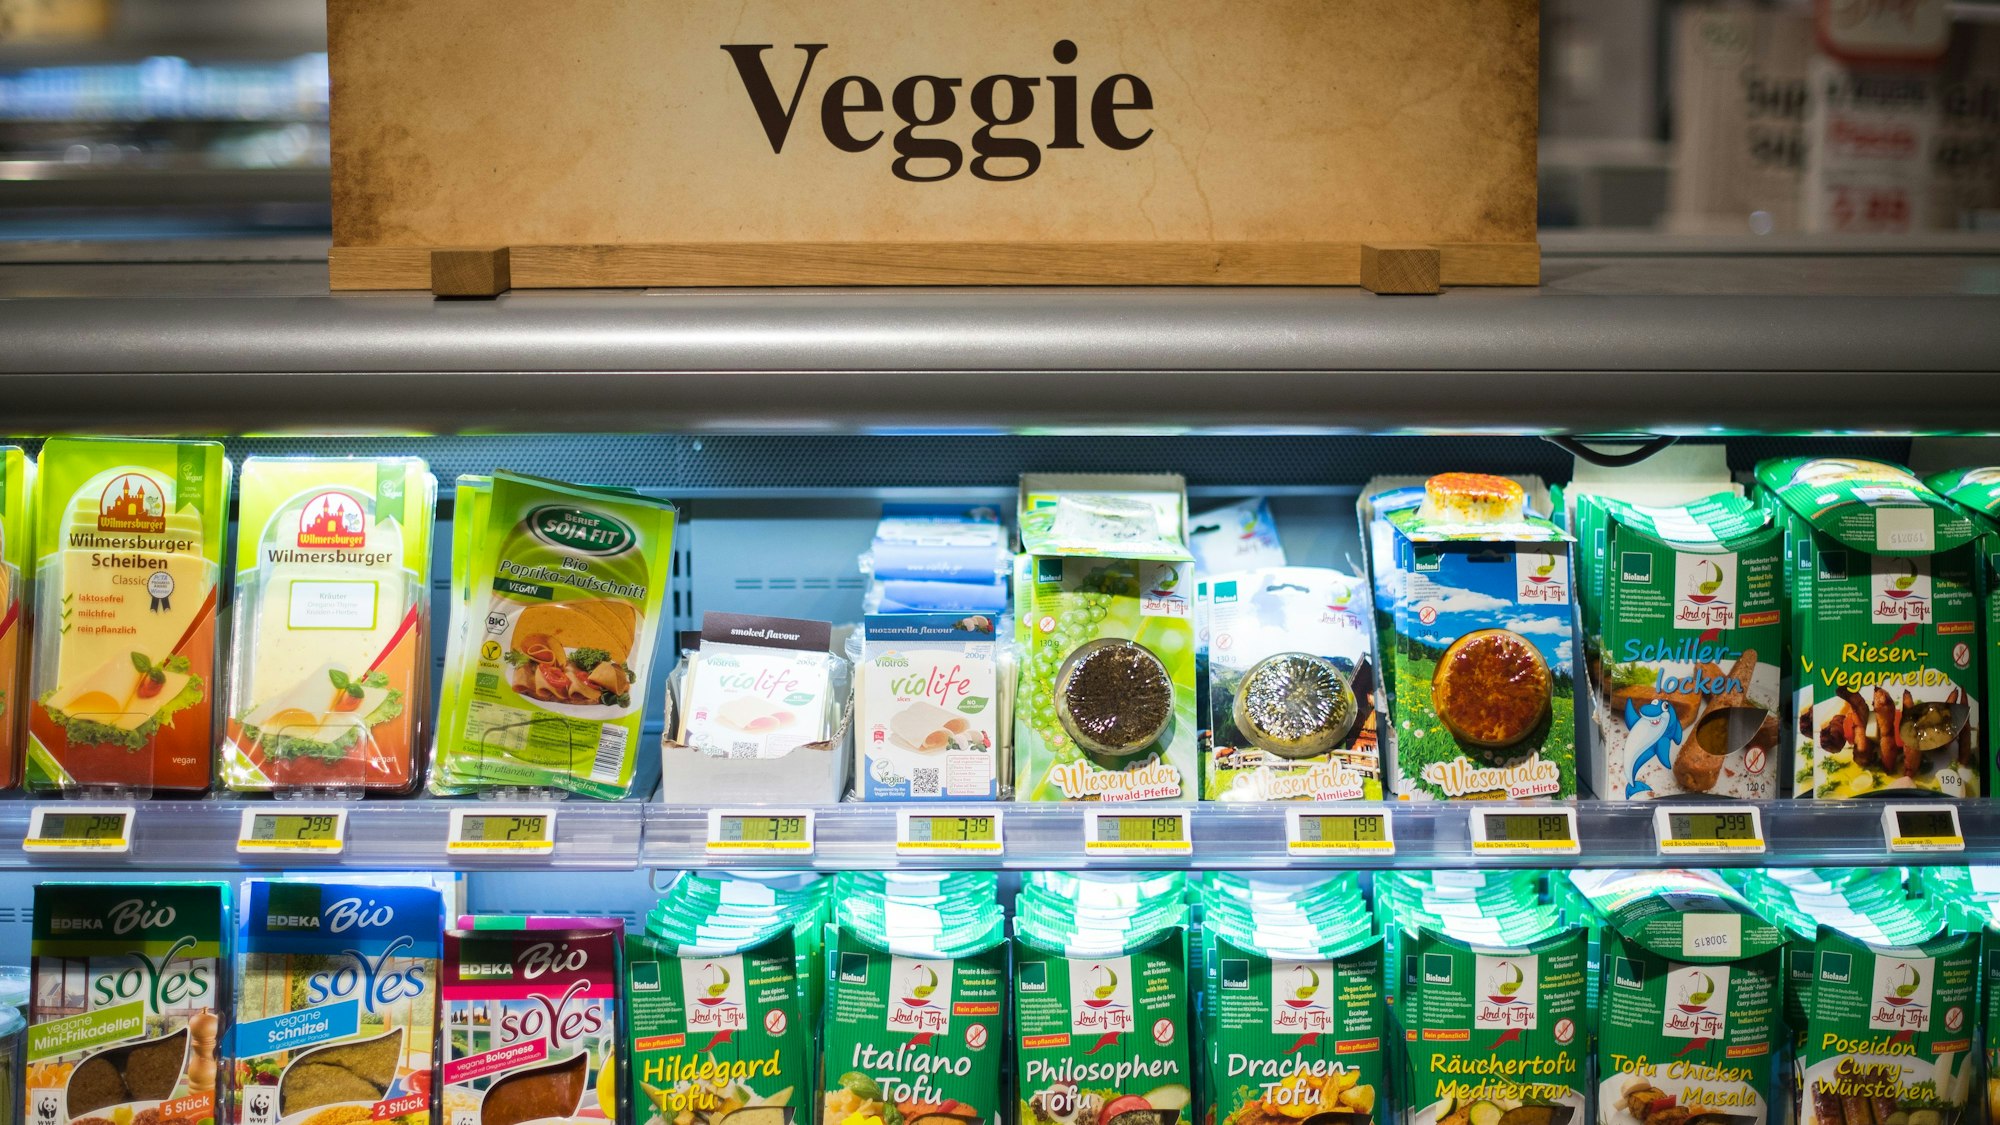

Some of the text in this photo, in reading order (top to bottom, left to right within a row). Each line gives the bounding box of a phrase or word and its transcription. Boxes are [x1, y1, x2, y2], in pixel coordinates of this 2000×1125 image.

[719, 39, 1154, 183] Veggie
[100, 517, 165, 531] Wilmersburger
[543, 519, 619, 545] SOJA FIT
[69, 533, 194, 553] Wilmersburger
[300, 534, 364, 547] Wilmersburger
[91, 553, 168, 569] Scheiben
[268, 549, 393, 566] Wilmersburger
[562, 556, 588, 572] Bio
[1416, 563, 1438, 571] Bioland
[112, 574, 147, 586] Classic
[499, 560, 647, 600] Paprika-Aufschnitt
[1040, 574, 1062, 582] Bioland
[1623, 572, 1649, 581] Bioland
[508, 582, 538, 595] VEGAN
[1520, 586, 1566, 602] Lord of Tofu
[78, 593, 124, 603] laktosefrei
[1144, 598, 1189, 615] Lord of Tofu
[78, 609, 116, 618] milchfrei
[1676, 606, 1734, 626] Lord of Tofu
[1874, 601, 1898, 615] Lord
[1898, 601, 1908, 620] of
[1907, 601, 1930, 620] Tofu
[95, 625, 137, 635] pflanzlich
[730, 628, 800, 641] smoked flavour
[869, 626, 954, 635] mozzarella flavour
[1418, 629, 1431, 637] 130
[1622, 637, 1742, 664] Schiller-
[1842, 643, 1929, 663] Riesen-
[480, 661, 499, 669] VEGAN
[875, 659, 909, 668] Viotros
[719, 669, 799, 699] violife
[890, 665, 971, 706] violife
[1655, 667, 1743, 695] locken
[1821, 665, 1951, 693] Vegarnelen
[172, 756, 196, 766] vegan
[371, 756, 397, 764] vegan
[880, 771, 905, 786] Vegan
[1746, 783, 1758, 791] 120
[1941, 776, 1962, 787] 150 g
[1103, 788, 1179, 801] Urwald-Pfeffer
[1316, 789, 1362, 801] Almliebe
[1512, 782, 1558, 796] Der Hirte
[51, 899, 176, 935] EDEKA Bio
[267, 897, 394, 933] EDEKA Bio
[1694, 934, 1728, 948] 300815
[459, 942, 588, 980] EDEKA Bio
[842, 973, 865, 983] Bioland
[1425, 973, 1450, 983] Bioland
[1616, 976, 1641, 988] Bioland
[1793, 970, 1813, 978] Biolan
[1822, 972, 1848, 981] Bioland
[634, 981, 659, 990] Bioland
[1021, 982, 1045, 990] Bioland
[1223, 979, 1247, 988] Bioland
[688, 1009, 712, 1024] Lord
[713, 1008, 722, 1027] of
[721, 1007, 745, 1027] Tofu
[970, 1005, 998, 1014] pflanzlich!
[1477, 1006, 1535, 1026] Lord of Tofu
[1872, 1007, 1928, 1028] Lord of Tofu
[46, 1015, 93, 1035] vegane
[274, 1011, 321, 1028] vegane
[889, 1008, 947, 1031] Lord of Tofu
[1073, 1011, 1098, 1026] Lord
[1098, 1010, 1108, 1030] of
[1107, 1009, 1132, 1029] Tofu
[1274, 1011, 1298, 1026] Lord
[1298, 1011, 1308, 1030] of
[1308, 1011, 1331, 1030] Tofu
[1665, 1014, 1723, 1035] Lord of Tofu
[34, 1015, 141, 1051] Mini-Frikadellen
[268, 1019, 329, 1043] Schnitzel
[307, 1032, 330, 1042] Panade
[1437, 1031, 1468, 1040] pflanzlich!
[652, 1038, 682, 1048] pflanzlich!
[1025, 1036, 1068, 1046] Rein pflanzlich!
[1822, 1033, 1917, 1056] Poseidon
[456, 1044, 534, 1071] vegane Bolognese
[852, 1042, 972, 1077] Italiano
[1228, 1052, 1360, 1078] Drachen-
[1430, 1051, 1577, 1075] Räuchertofu
[643, 1049, 782, 1088] Hildegard
[1026, 1054, 1179, 1088] Philosophen
[1610, 1053, 1754, 1082] Tofu Chicken
[1837, 1056, 1914, 1083] Curry-
[875, 1074, 942, 1105] Tofu
[1259, 1078, 1320, 1105] Tofu
[1434, 1077, 1572, 1100] Mediterran
[1681, 1086, 1757, 1106] Masala
[1818, 1076, 1936, 1100] Würstchen
[164, 1097, 210, 1116] 5 Stück
[378, 1096, 424, 1116] 2 Stück
[655, 1084, 716, 1112] Tofu
[1034, 1085, 1092, 1112] Tofu
